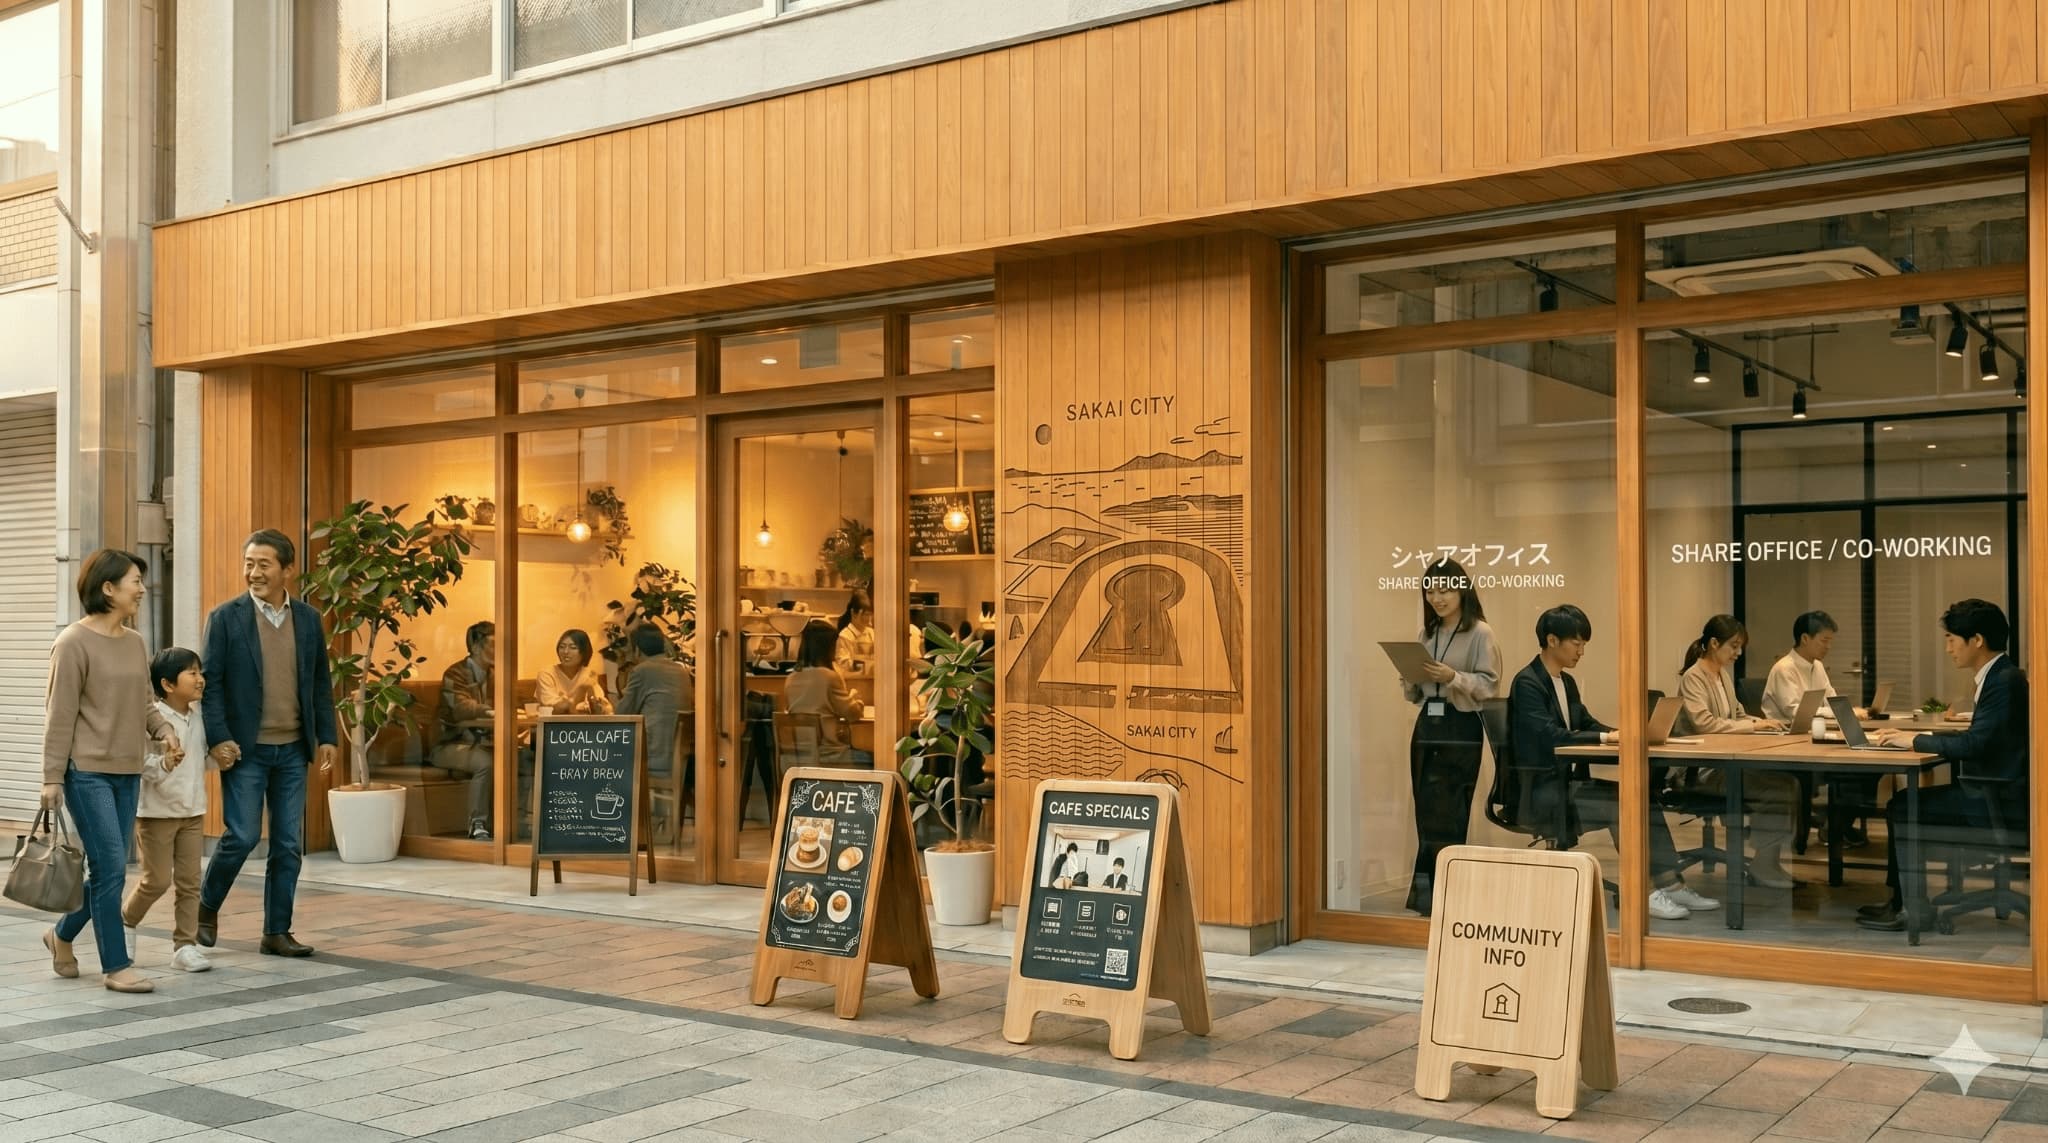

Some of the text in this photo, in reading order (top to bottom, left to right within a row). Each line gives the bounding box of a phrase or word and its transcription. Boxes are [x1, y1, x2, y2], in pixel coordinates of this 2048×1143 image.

[1066, 395, 1175, 421] SAKAI CITY
[1391, 543, 1551, 569] シャアオフィス
[1671, 535, 1993, 564] SHARE OFFICE / CO-WORKING
[1378, 574, 1565, 590] SHARE OFFICE / CO-WORKING
[550, 730, 592, 744] LOCAL
[1126, 724, 1197, 739] SAKAI CITY
[571, 748, 609, 762] MENU
[593, 768, 624, 780] BREW
[811, 790, 859, 814] CAFE
[1049, 801, 1151, 821] CAFE SPECIALS
[1452, 921, 1564, 968] COMMUNITY INFO
